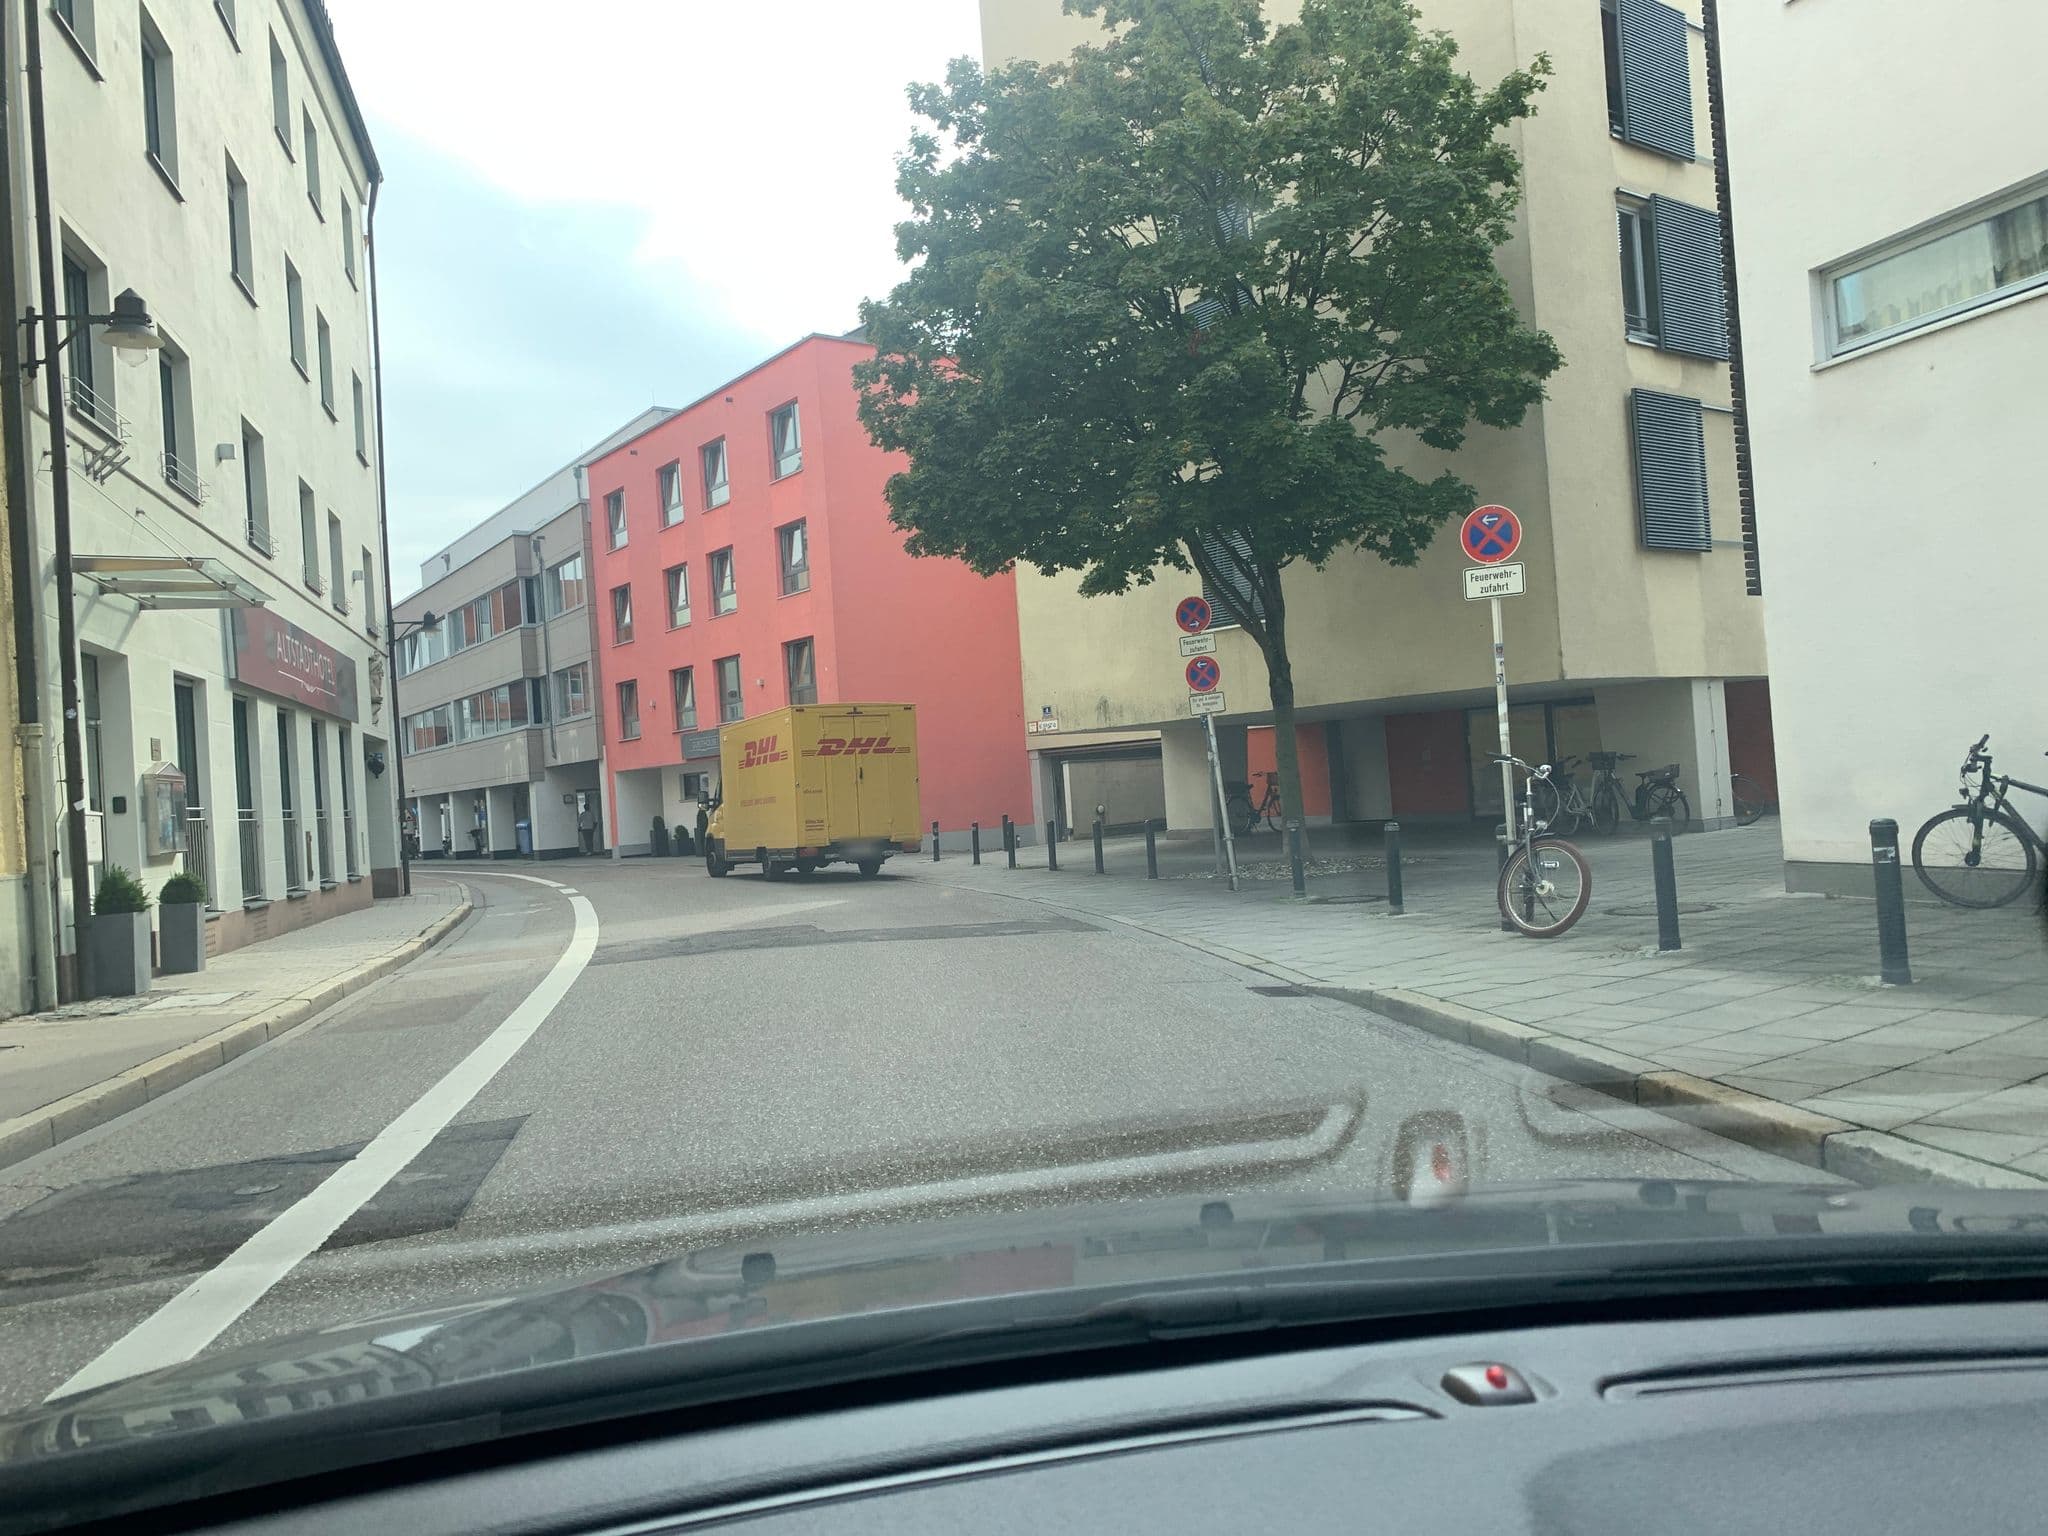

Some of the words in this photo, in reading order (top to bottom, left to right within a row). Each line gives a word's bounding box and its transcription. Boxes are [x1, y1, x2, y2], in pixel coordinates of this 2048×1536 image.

[1470, 569, 1518, 583] Feuerwehr-
[1480, 582, 1509, 594] zufahrt
[277, 631, 336, 686] ALTSTADTHOTEL
[744, 734, 781, 769] DHL
[816, 736, 897, 757] DHL
